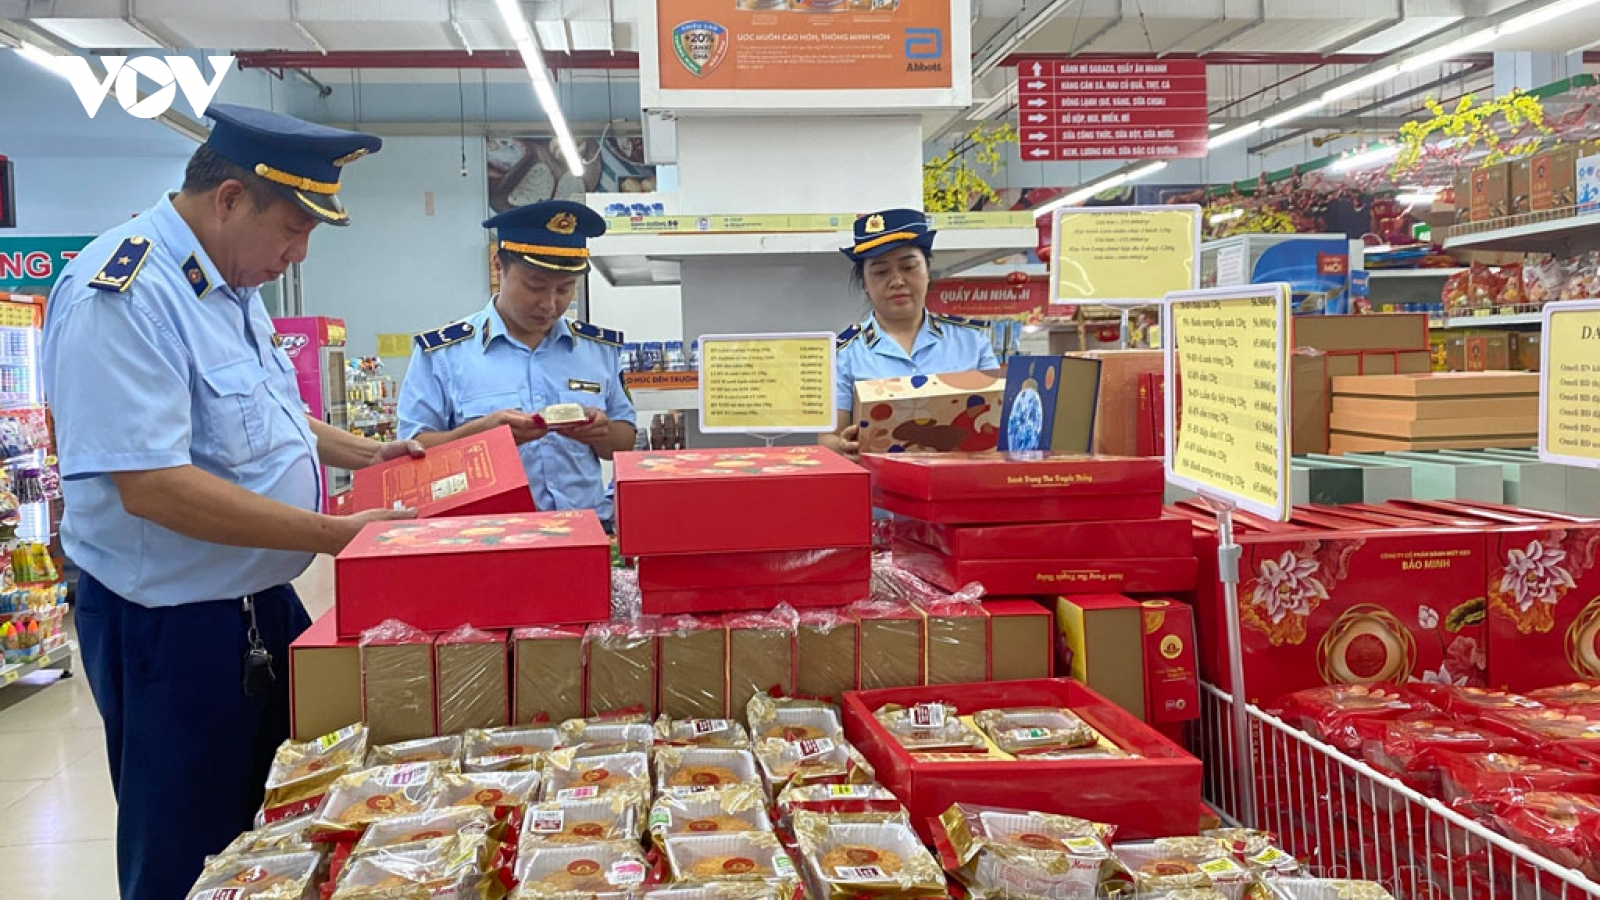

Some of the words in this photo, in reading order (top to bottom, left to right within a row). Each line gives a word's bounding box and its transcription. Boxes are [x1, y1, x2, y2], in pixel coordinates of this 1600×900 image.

[684, 33, 715, 43] +20%
[906, 62, 942, 72] Abbott
[1402, 559, 1422, 570] BẢO
[1425, 558, 1450, 568] MINH
[1072, 858, 1091, 869] Moon
